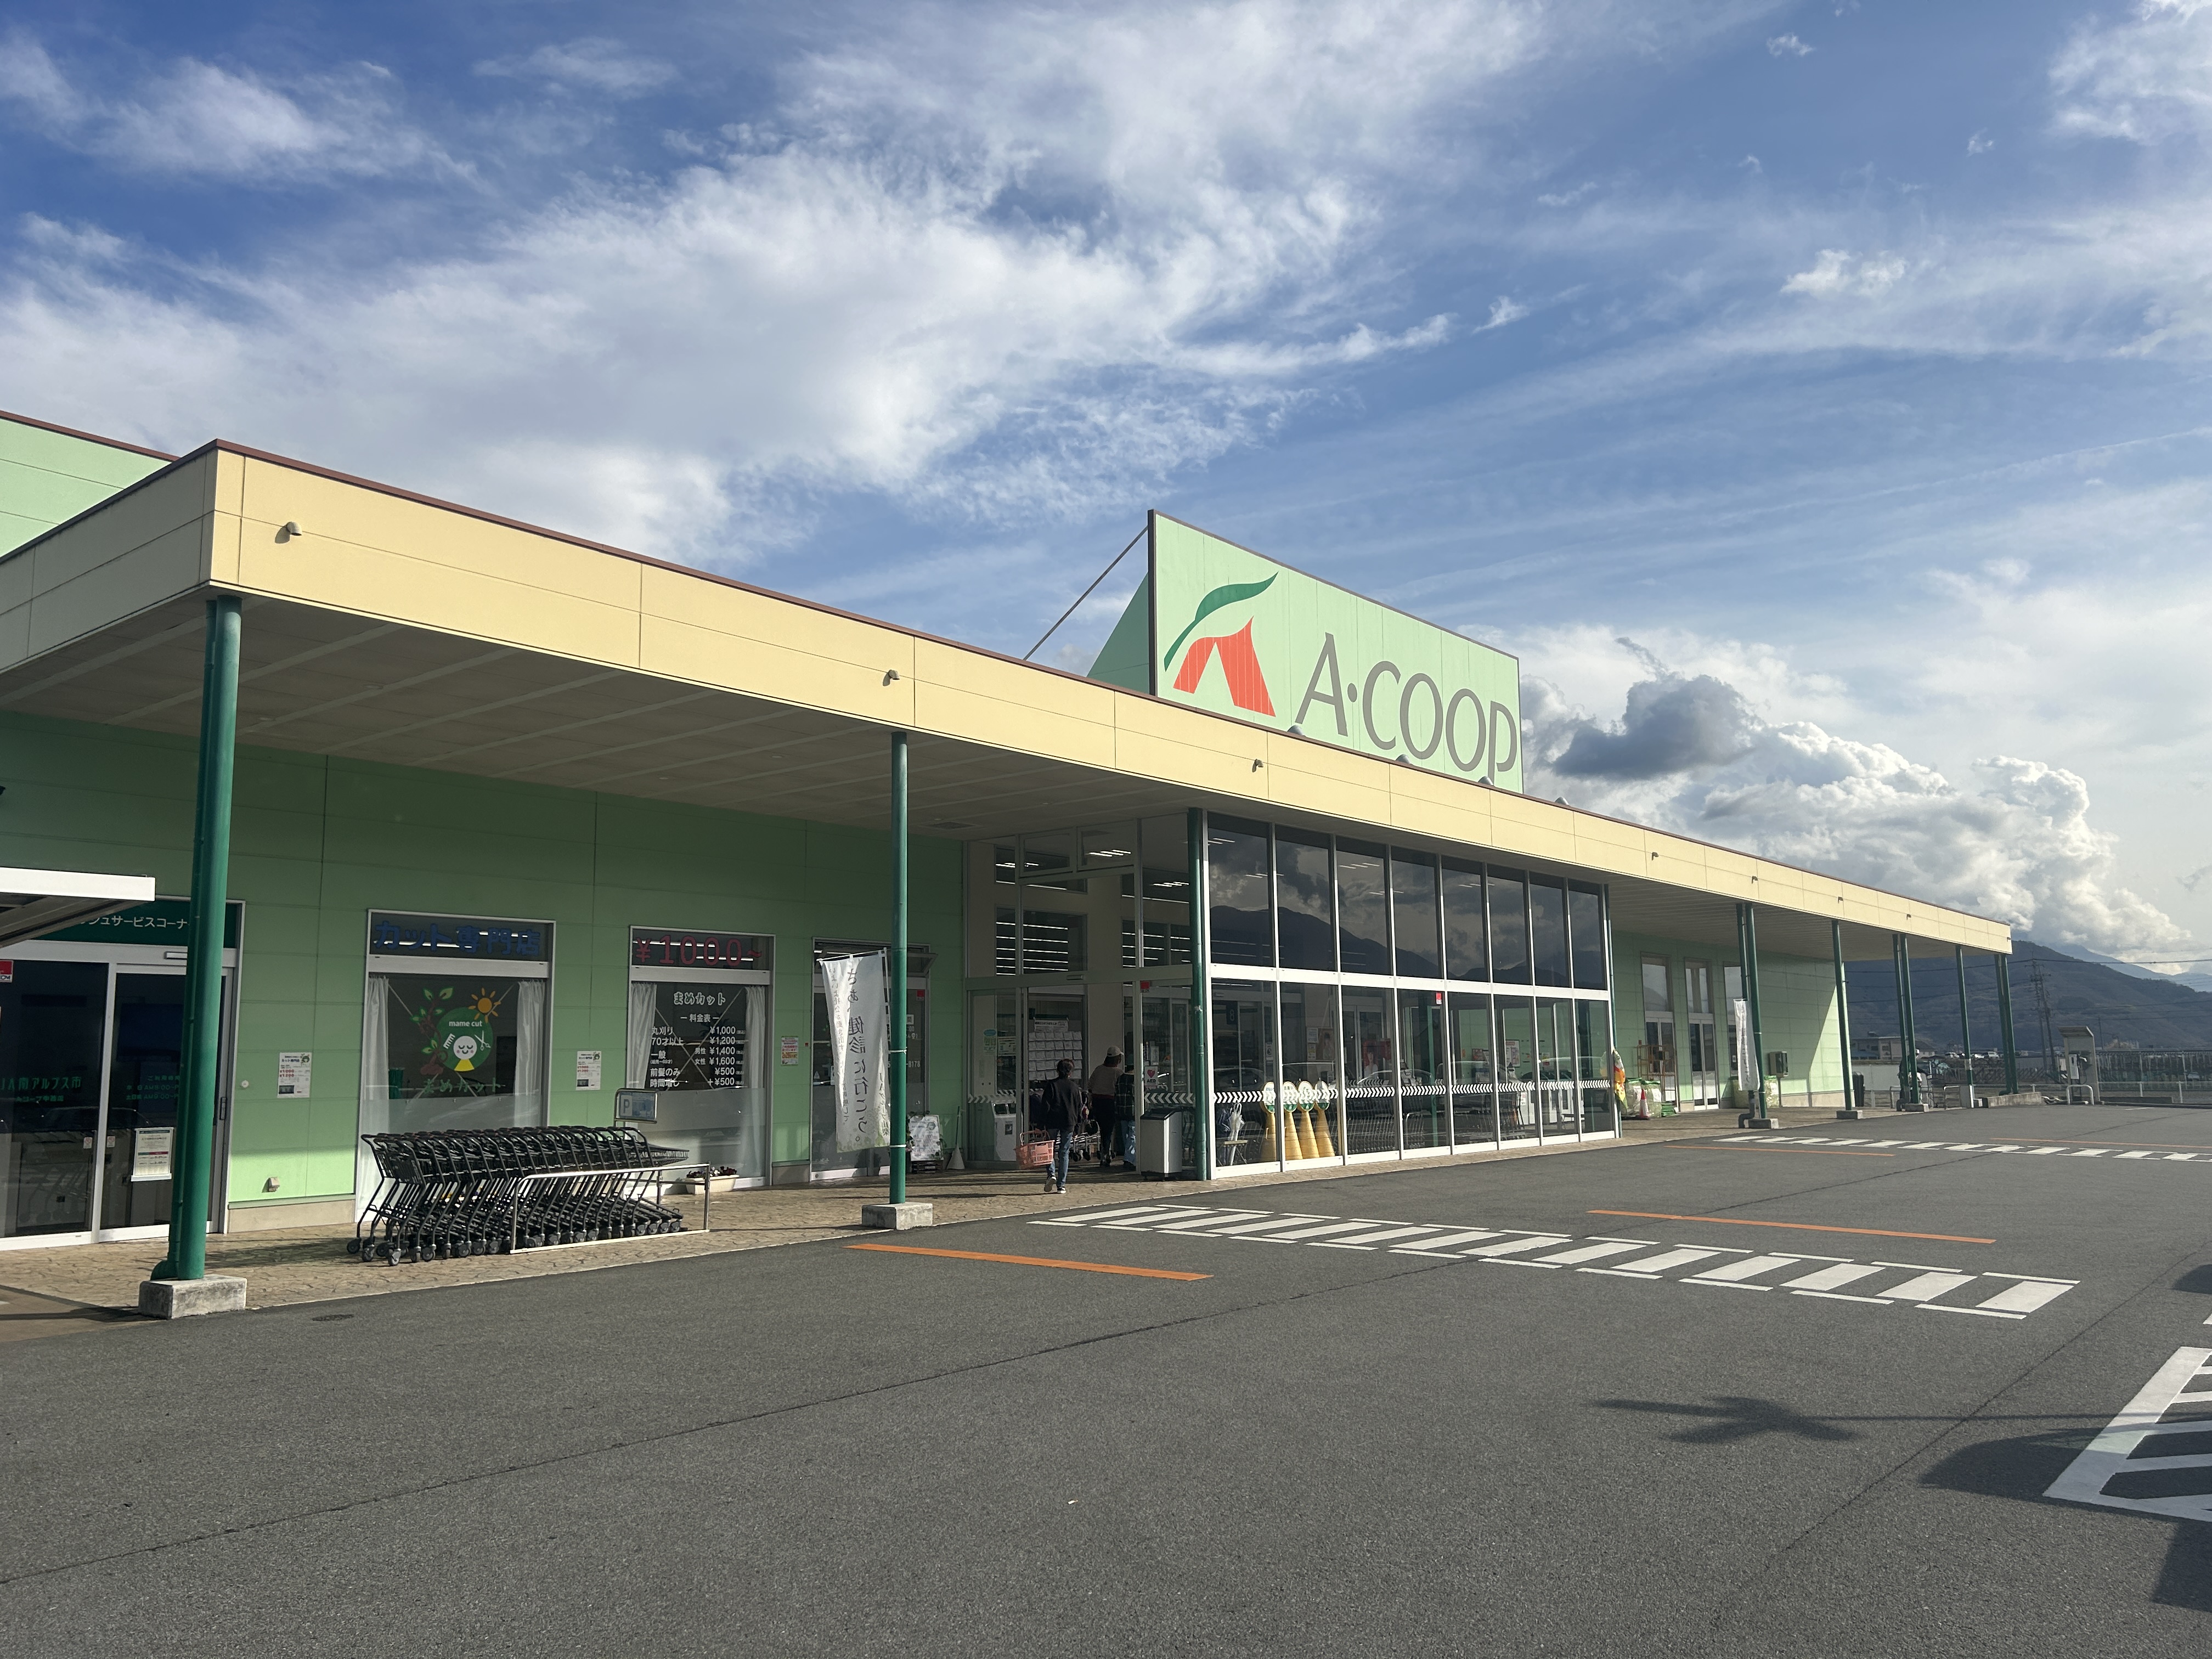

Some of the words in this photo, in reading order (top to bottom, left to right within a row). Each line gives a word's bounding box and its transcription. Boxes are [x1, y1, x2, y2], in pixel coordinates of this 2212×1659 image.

[81, 915, 190, 929] シュサービスコーナ
[374, 921, 540, 956] カット専門店
[674, 991, 726, 1006] まめカット
[651, 1026, 673, 1035] 丸刈り
[709, 1026, 736, 1035] ¥1,000
[709, 1036, 736, 1045] ¥1,200
[651, 1050, 666, 1059] 一般
[709, 1046, 735, 1056] ¥1,400
[709, 1057, 735, 1065] ¥1,600
[650, 1068, 681, 1077] 前髪のみ
[714, 1067, 735, 1076] ¥500
[423, 1077, 501, 1094] まめカット
[623, 1099, 630, 1114] P
